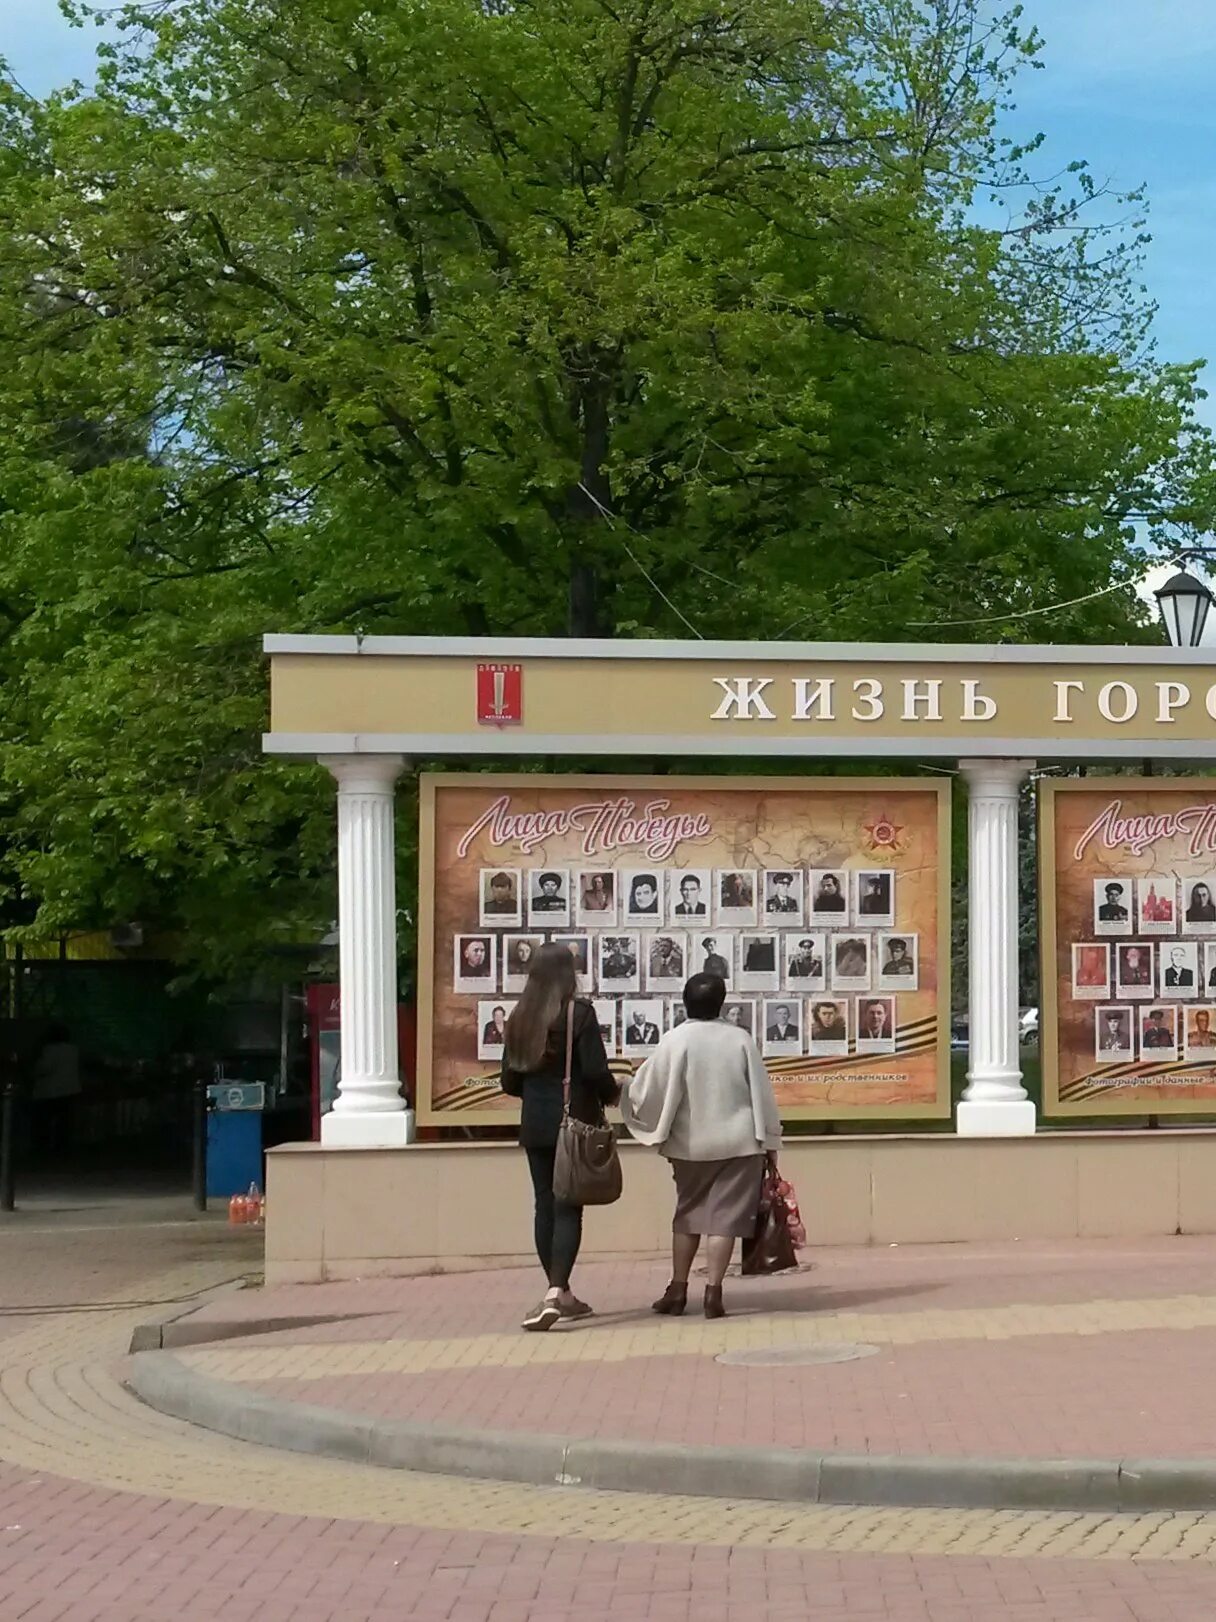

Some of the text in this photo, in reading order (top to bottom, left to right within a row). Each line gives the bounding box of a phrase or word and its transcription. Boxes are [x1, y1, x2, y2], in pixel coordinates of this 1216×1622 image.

[710, 677, 997, 720] ЖИЗНЬ
[457, 795, 711, 862] Лица Победы
[1073, 800, 1176, 860] Лица
